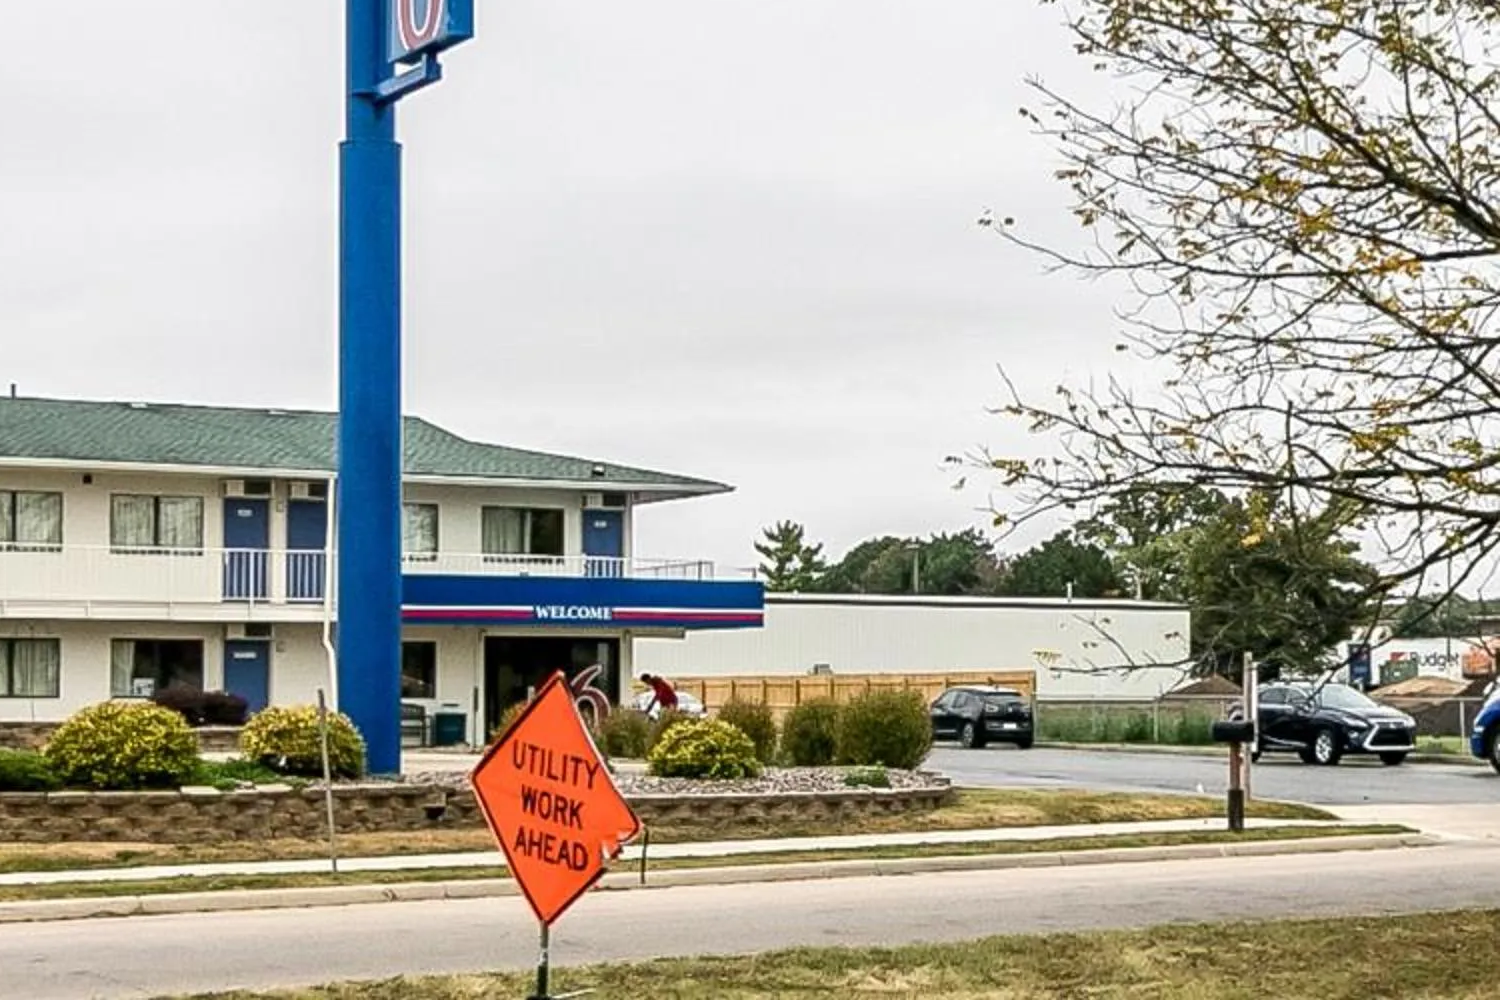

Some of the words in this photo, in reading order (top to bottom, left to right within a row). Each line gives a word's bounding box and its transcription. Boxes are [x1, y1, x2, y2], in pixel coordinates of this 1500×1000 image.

[535, 605, 613, 620] WELCOME
[512, 738, 600, 791] UTILITY
[521, 783, 584, 830] WORK
[514, 824, 589, 872] AHEAD
